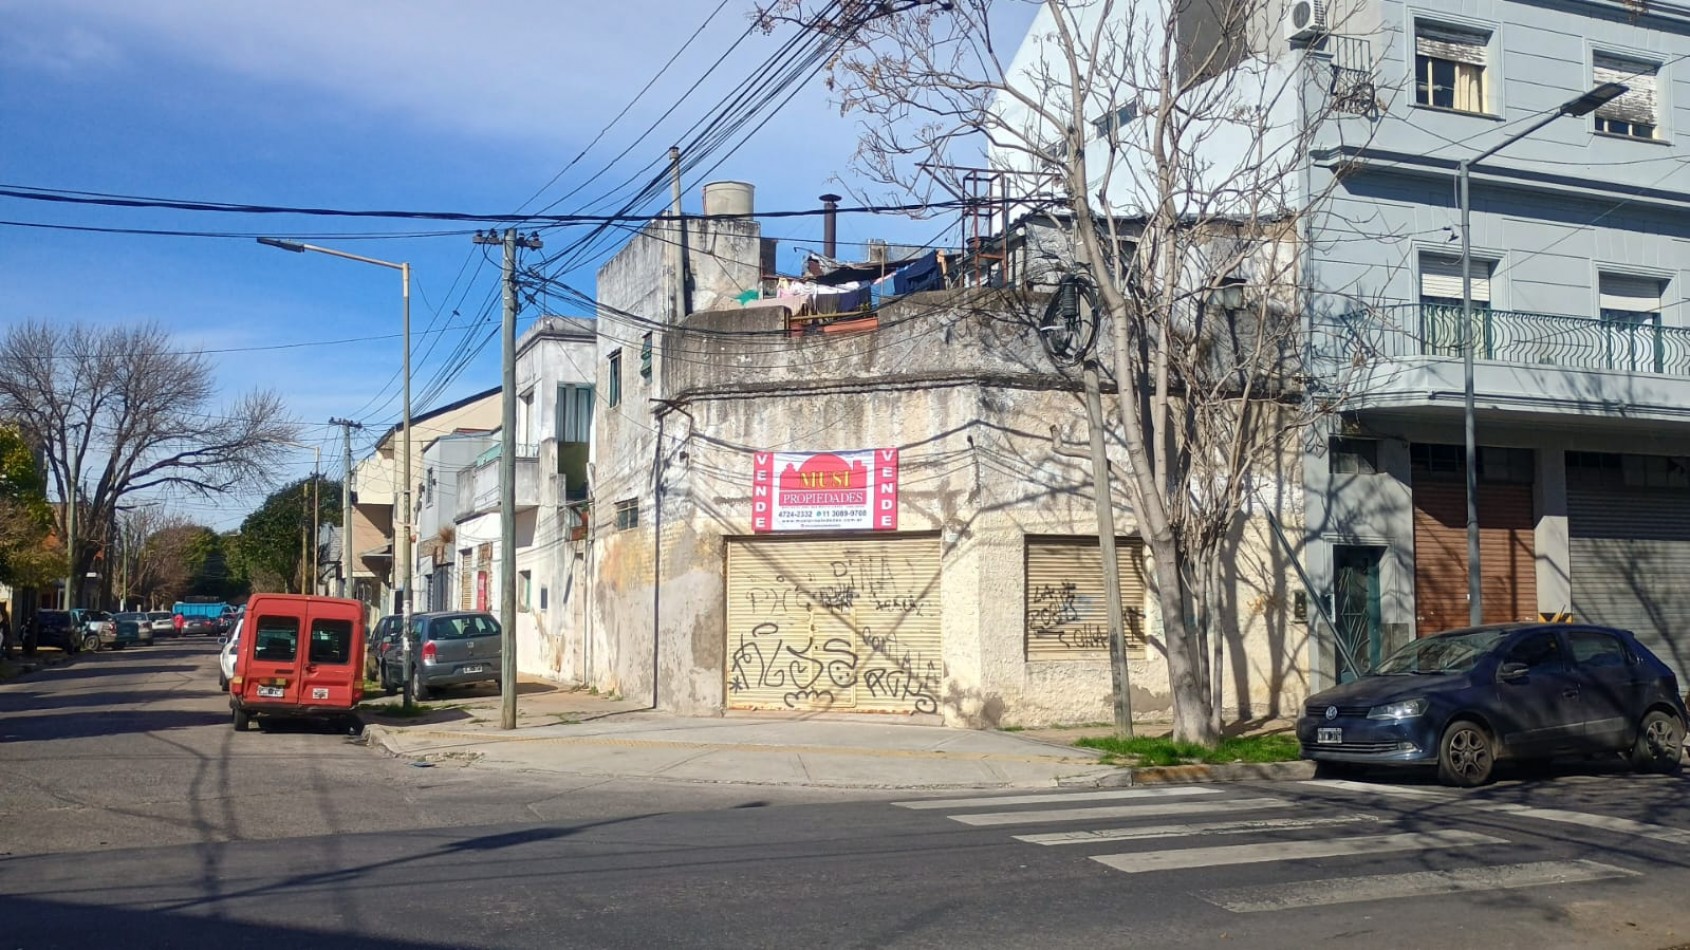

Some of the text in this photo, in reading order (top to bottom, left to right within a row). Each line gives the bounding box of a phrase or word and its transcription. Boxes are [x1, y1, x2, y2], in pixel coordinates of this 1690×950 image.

[755, 454, 768, 528] VENDE
[783, 492, 863, 504] PROPIEDADES
[881, 450, 894, 526] VENDE
